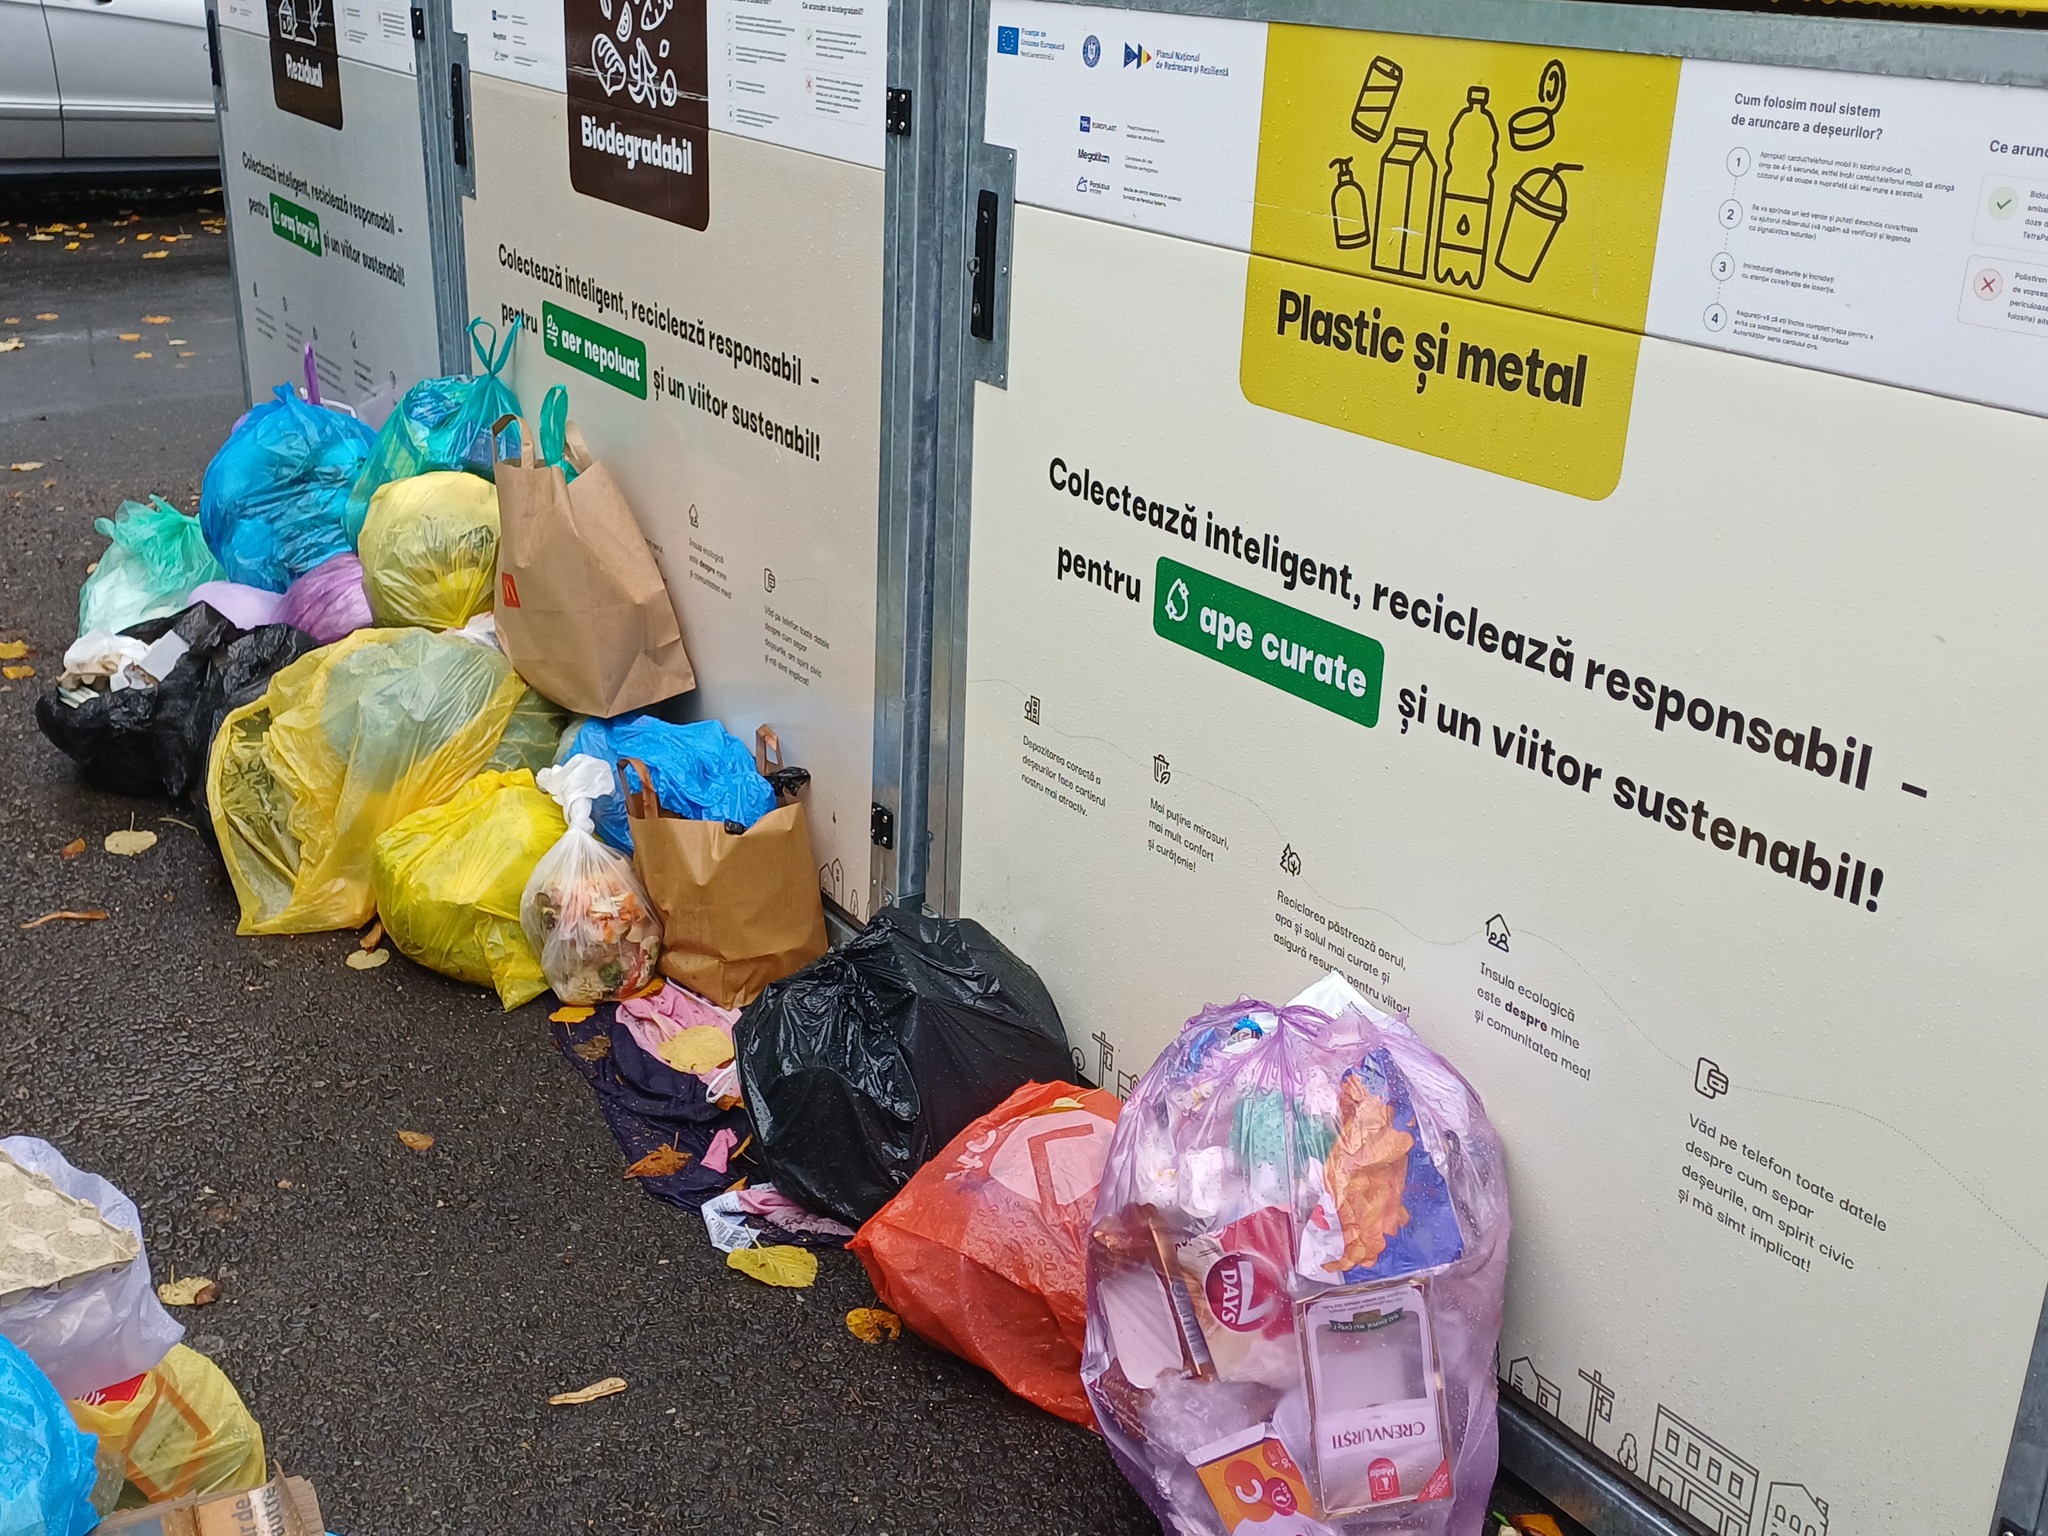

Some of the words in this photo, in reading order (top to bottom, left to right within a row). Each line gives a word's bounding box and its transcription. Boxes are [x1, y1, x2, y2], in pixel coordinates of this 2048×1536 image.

[285, 52, 324, 88] Rezidual
[1731, 114, 1746, 126] de
[1748, 118, 1800, 132] aruncare
[1802, 122, 1810, 132] a
[1812, 122, 1882, 140] deșeurilor?
[1734, 92, 1760, 106] Cum
[1764, 95, 1806, 110] folosim
[1810, 102, 1836, 114] noul
[1838, 102, 1880, 118] sistem
[580, 114, 693, 175] Biodegradabil
[1990, 140, 2008, 154] Ce
[1726, 208, 1734, 221] 2
[1719, 261, 1726, 274] 3
[498, 243, 562, 290] Colectează
[564, 267, 628, 320] inteligent,
[631, 297, 705, 347] reciclează
[708, 326, 802, 386] responsabil
[1712, 312, 1719, 324] 4
[561, 325, 582, 353] aer
[584, 338, 641, 383] nepoluat
[1276, 288, 1405, 364] Plastic
[1414, 322, 1450, 394] și
[1456, 342, 1588, 408] metal
[653, 366, 665, 401] și
[668, 374, 686, 402] un
[688, 381, 728, 420] viitor
[732, 402, 821, 463] sustenabil!
[1057, 546, 1142, 603] pentru
[1049, 457, 1198, 542] Colectează
[1204, 511, 1361, 611] inteligent,
[1372, 582, 1575, 683] reciclează
[1585, 657, 1873, 792] responsabil
[1200, 605, 1253, 651] ape
[1261, 632, 1367, 698] curate
[1022, 755, 1056, 780] deșeurilor
[1058, 772, 1074, 790] face
[1075, 782, 1106, 807] cartierul
[1023, 735, 1065, 767] Depozitarea
[1066, 760, 1095, 782] corectă
[1096, 776, 1101, 785] a
[1021, 772, 1044, 792] nostru
[1044, 786, 1058, 800] mai
[1058, 794, 1088, 817] atractiv.
[1150, 797, 1164, 814] Mai
[1166, 808, 1192, 829] puține
[1193, 822, 1229, 850] mirosuri,
[1398, 684, 1428, 735] și
[1438, 702, 1481, 748] un
[1492, 724, 1602, 794] viitor
[1613, 775, 1885, 913] sustenabil!
[1148, 819, 1163, 834] mai
[1164, 827, 1182, 844] mult
[1184, 836, 1214, 862] confort
[1148, 838, 1154, 852] și
[1156, 843, 1196, 873] curățenie!
[1275, 912, 1292, 929] apa
[1294, 923, 1302, 936] și
[1304, 928, 1326, 948] solul
[1328, 941, 1345, 959] mai
[1348, 953, 1379, 977] curate
[1382, 971, 1390, 986] și
[1277, 890, 1326, 926] Reciclarea
[1328, 919, 1376, 953] păstrează
[1378, 946, 1406, 971] aerul,
[1274, 932, 1307, 958] asigură
[1347, 976, 1380, 1000] pentru
[1480, 962, 1515, 990] Insula
[1518, 984, 1576, 1022] ecologică
[1474, 1009, 1484, 1024] și
[1486, 1017, 1558, 1063] comunitatea
[1561, 1056, 1591, 1082] mea!
[1477, 987, 1501, 1007] este
[1504, 1000, 1548, 1032] despre
[1550, 1026, 1580, 1050] mine
[1685, 1140, 1734, 1175] despre
[1737, 1168, 1768, 1195] cum
[1772, 1188, 1815, 1219] separ
[1689, 1112, 1716, 1139] Văd
[1720, 1132, 1738, 1151] pe
[1742, 1143, 1792, 1181] telefon
[1796, 1172, 1834, 1204] toate
[1838, 1199, 1888, 1232] datele
[1678, 1187, 1690, 1204] și
[1692, 1196, 1714, 1217] mă
[1716, 1209, 1747, 1236] simt
[1750, 1227, 1811, 1274] implicat!
[1681, 1164, 1748, 1213] deșeurile,
[1752, 1204, 1774, 1226] am
[1778, 1218, 1816, 1249] spirit
[1819, 1242, 1855, 1270] civic
[1220, 1268, 1240, 1325] DAYS
[1236, 1260, 1275, 1326] 7
